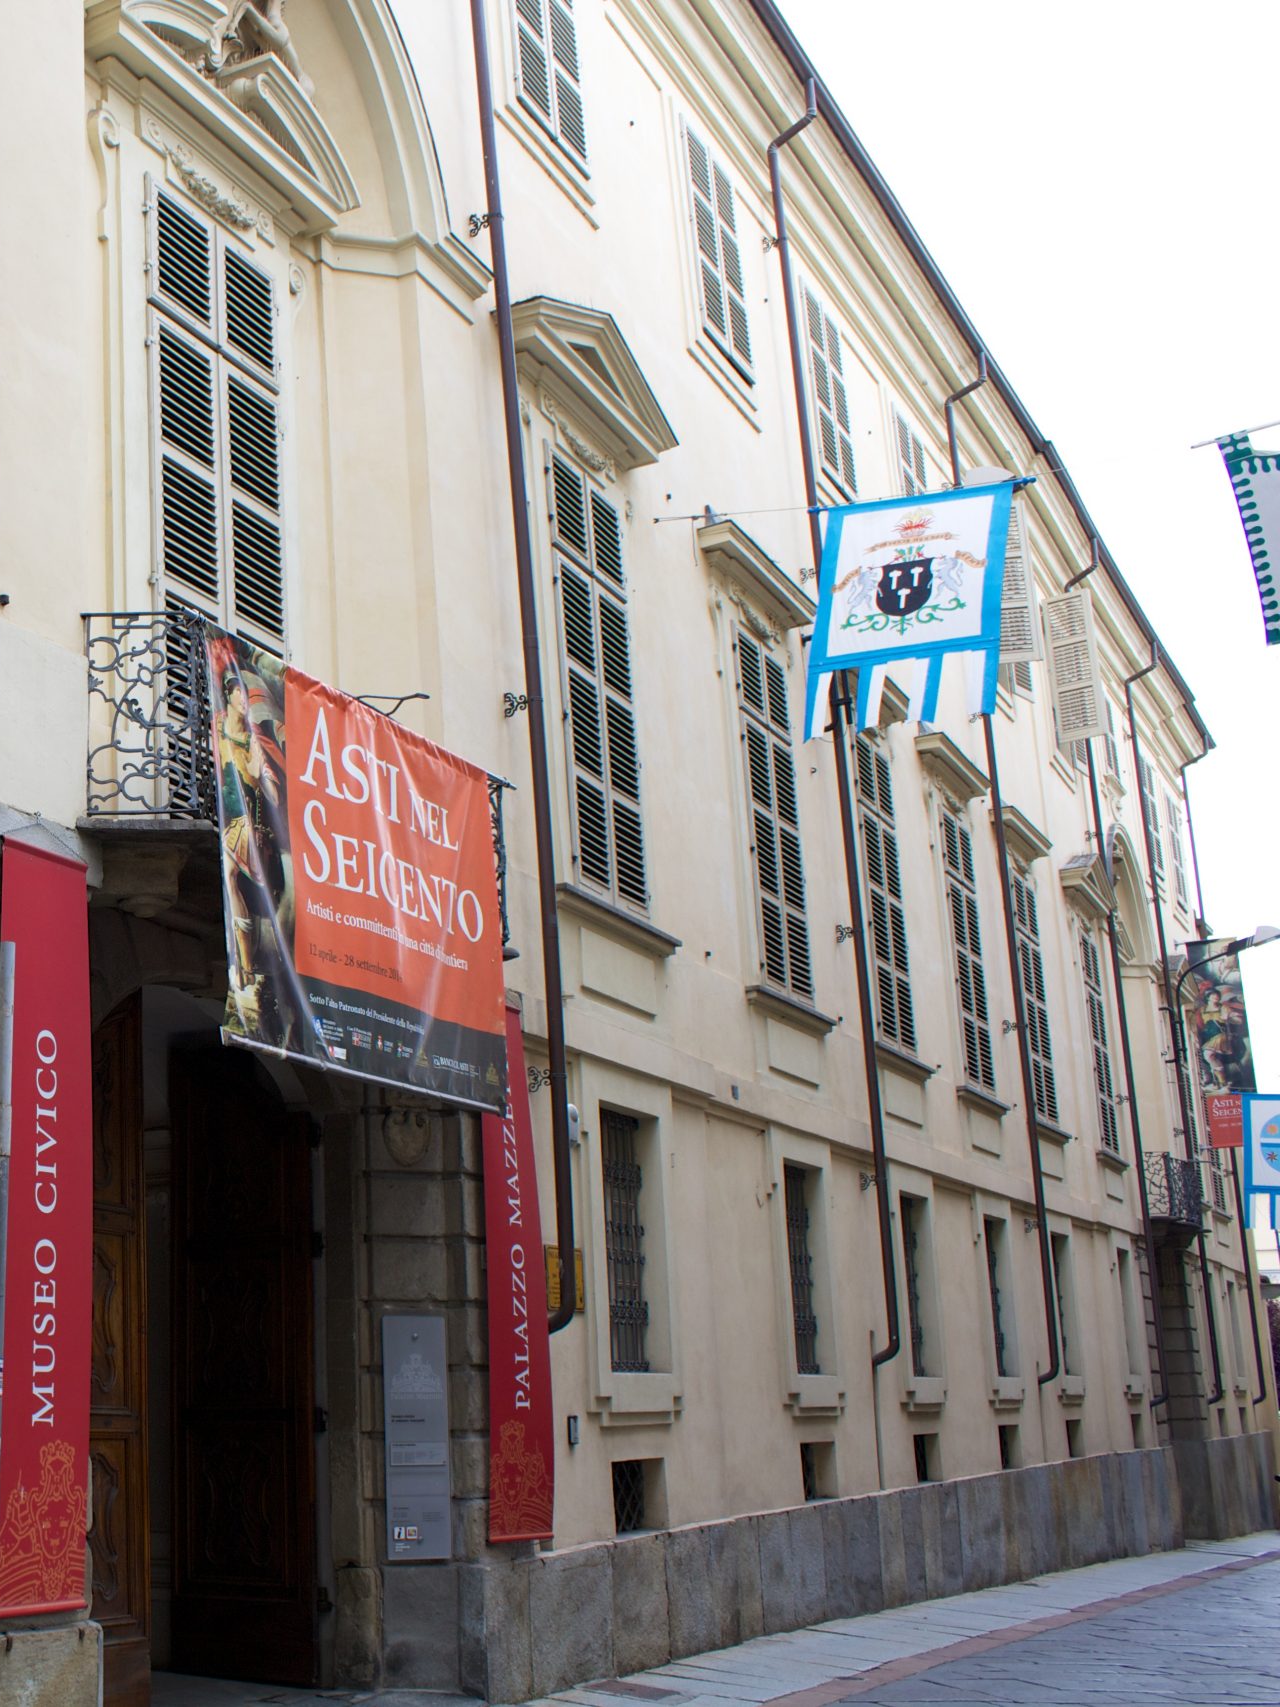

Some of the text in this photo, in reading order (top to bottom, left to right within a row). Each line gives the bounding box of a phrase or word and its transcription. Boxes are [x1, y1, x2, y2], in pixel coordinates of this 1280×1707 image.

[299, 706, 459, 851] ASTI NEL
[303, 799, 484, 942] SEICENTO
[306, 898, 334, 922] Artisti
[335, 914, 342, 924] e
[343, 915, 398, 941] committenti
[344, 954, 355, 967] 28
[309, 992, 325, 1006] Sotto
[338, 1001, 366, 1016] Patronato
[1213, 1108, 1242, 1116] SEICEN
[31, 1029, 58, 1428] MUSEO CIVICO
[504, 1062, 531, 1410] PALAZZO MAZZE
